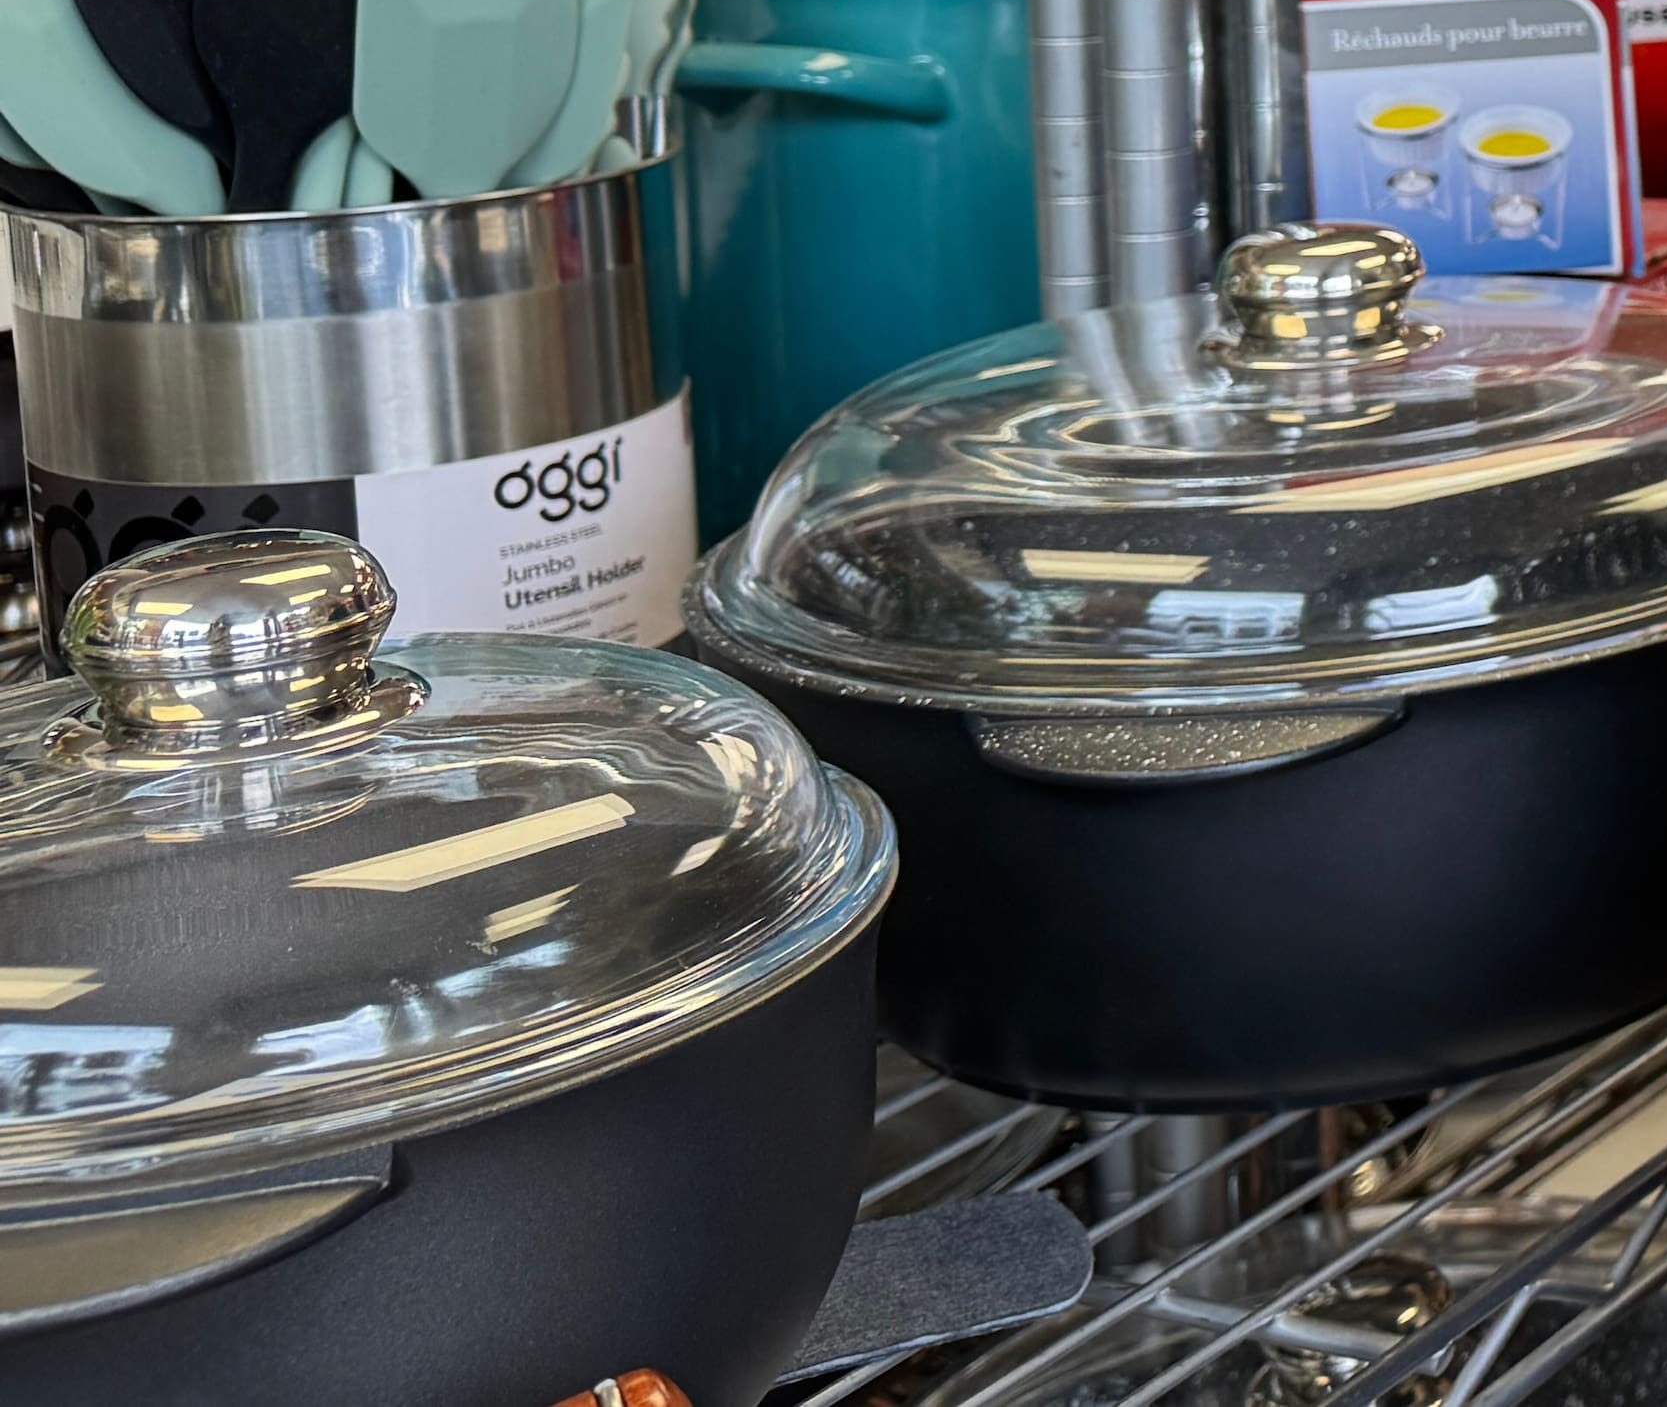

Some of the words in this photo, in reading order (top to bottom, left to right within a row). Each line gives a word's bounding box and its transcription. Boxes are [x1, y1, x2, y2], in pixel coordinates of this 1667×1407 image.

[1331, 22, 1442, 53] Réchauds
[1448, 26, 1506, 53] pour
[1507, 17, 1588, 40] beurre
[494, 435, 623, 522] oggi
[499, 534, 569, 560] STAINLESS
[570, 522, 602, 541] STEEL
[502, 554, 577, 587] Jumbo
[504, 574, 584, 611] Utensil
[587, 554, 647, 590] Holder
